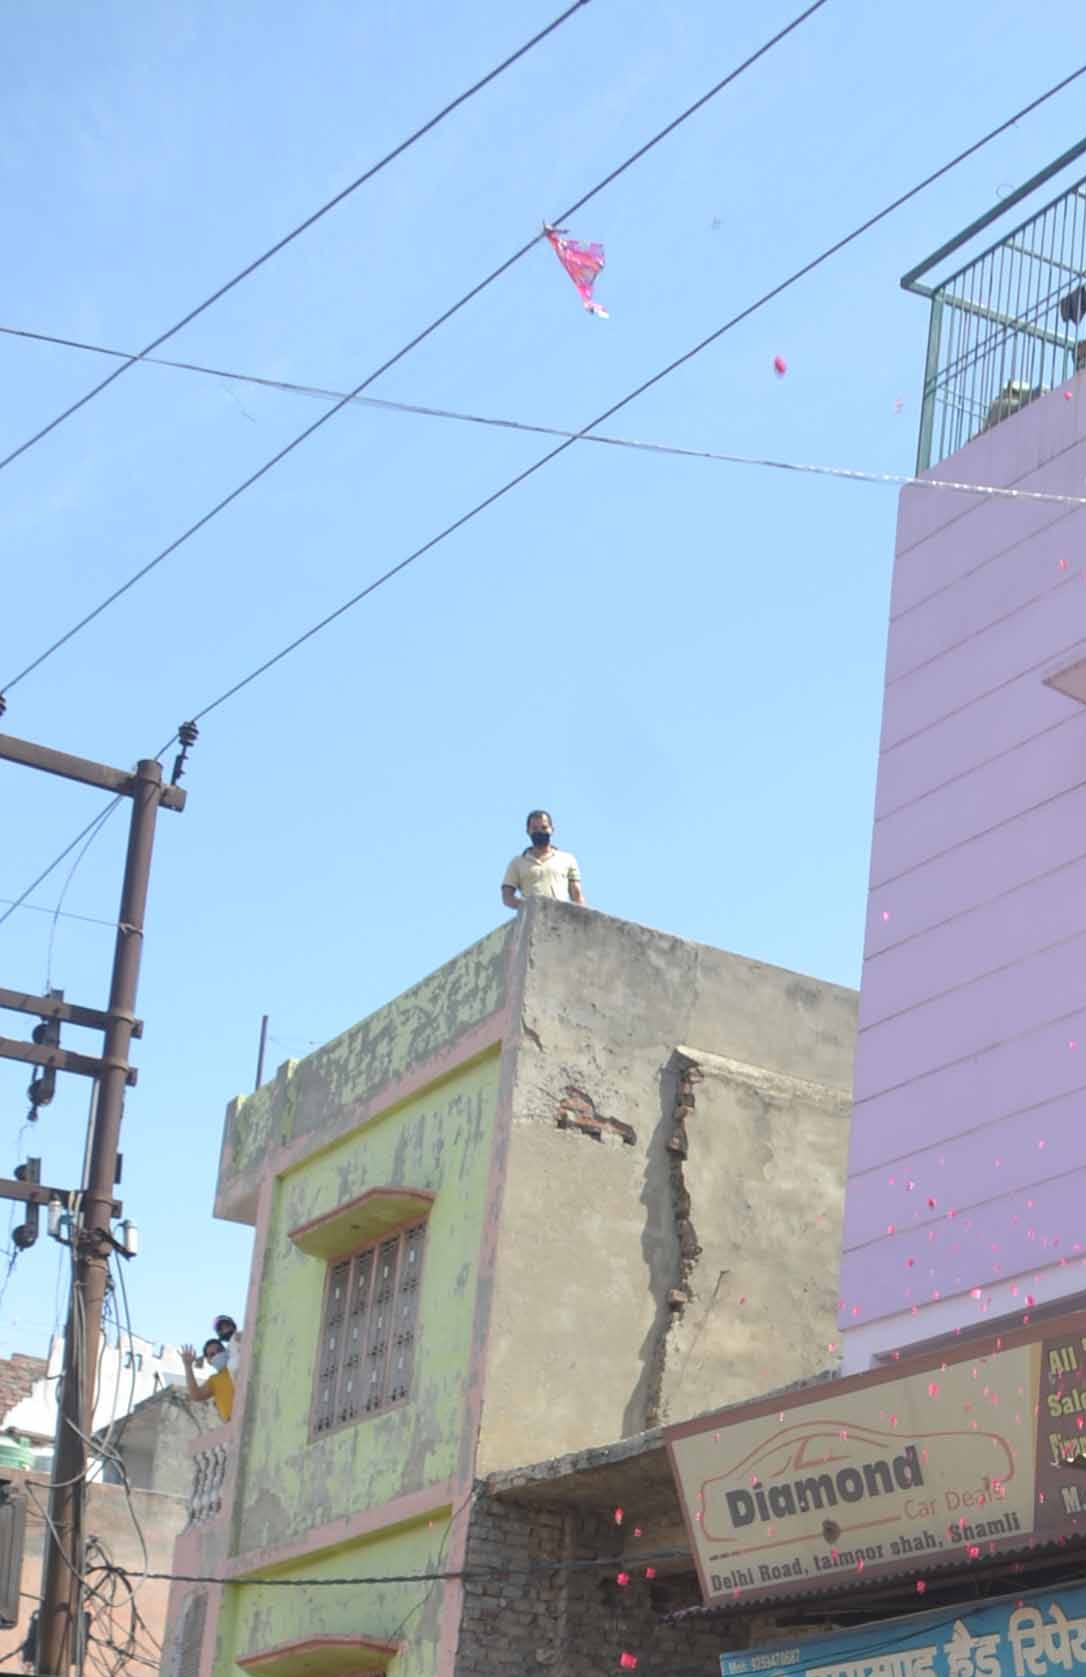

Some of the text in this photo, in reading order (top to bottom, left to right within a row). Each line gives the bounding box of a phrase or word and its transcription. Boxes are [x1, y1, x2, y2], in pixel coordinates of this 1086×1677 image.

[1049, 1347, 1078, 1376] All
[725, 1445, 925, 1529] Diamond
[904, 1492, 938, 1522] Car
[710, 1563, 755, 1593] Delhi
[948, 1511, 1022, 1545] Shamli
